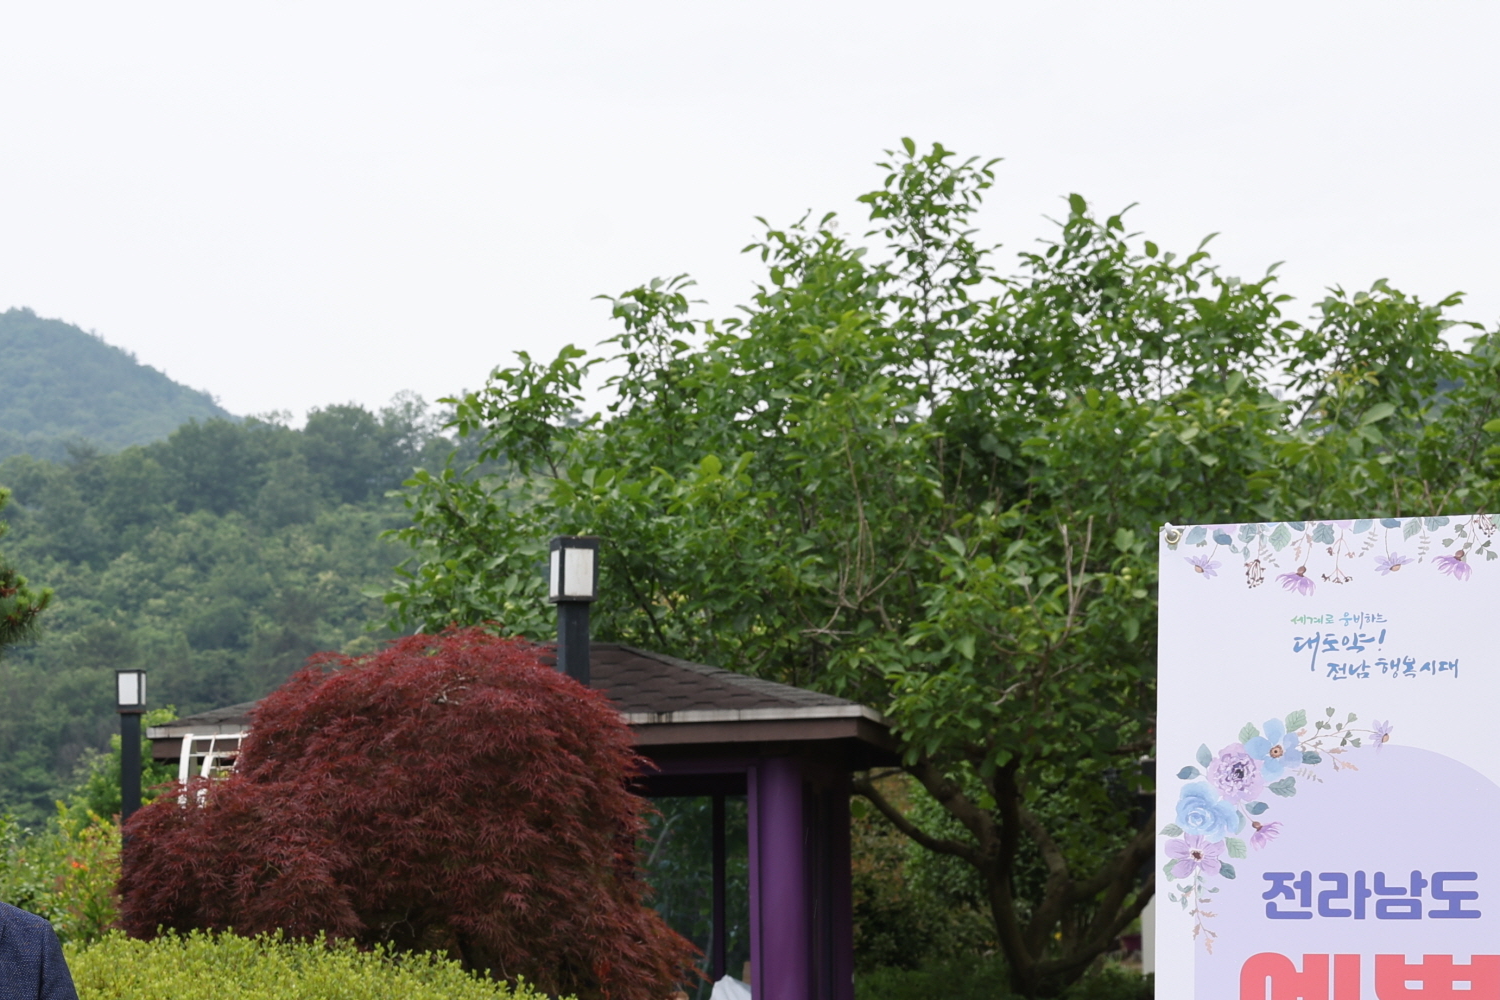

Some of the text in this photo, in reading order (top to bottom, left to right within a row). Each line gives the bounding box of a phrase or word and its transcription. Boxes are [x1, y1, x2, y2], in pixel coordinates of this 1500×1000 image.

[1290, 613, 1335, 625] 세계로
[1292, 628, 1387, 672] 대도약!
[1326, 659, 1371, 681] 전남
[1260, 869, 1482, 920] 전라남도
